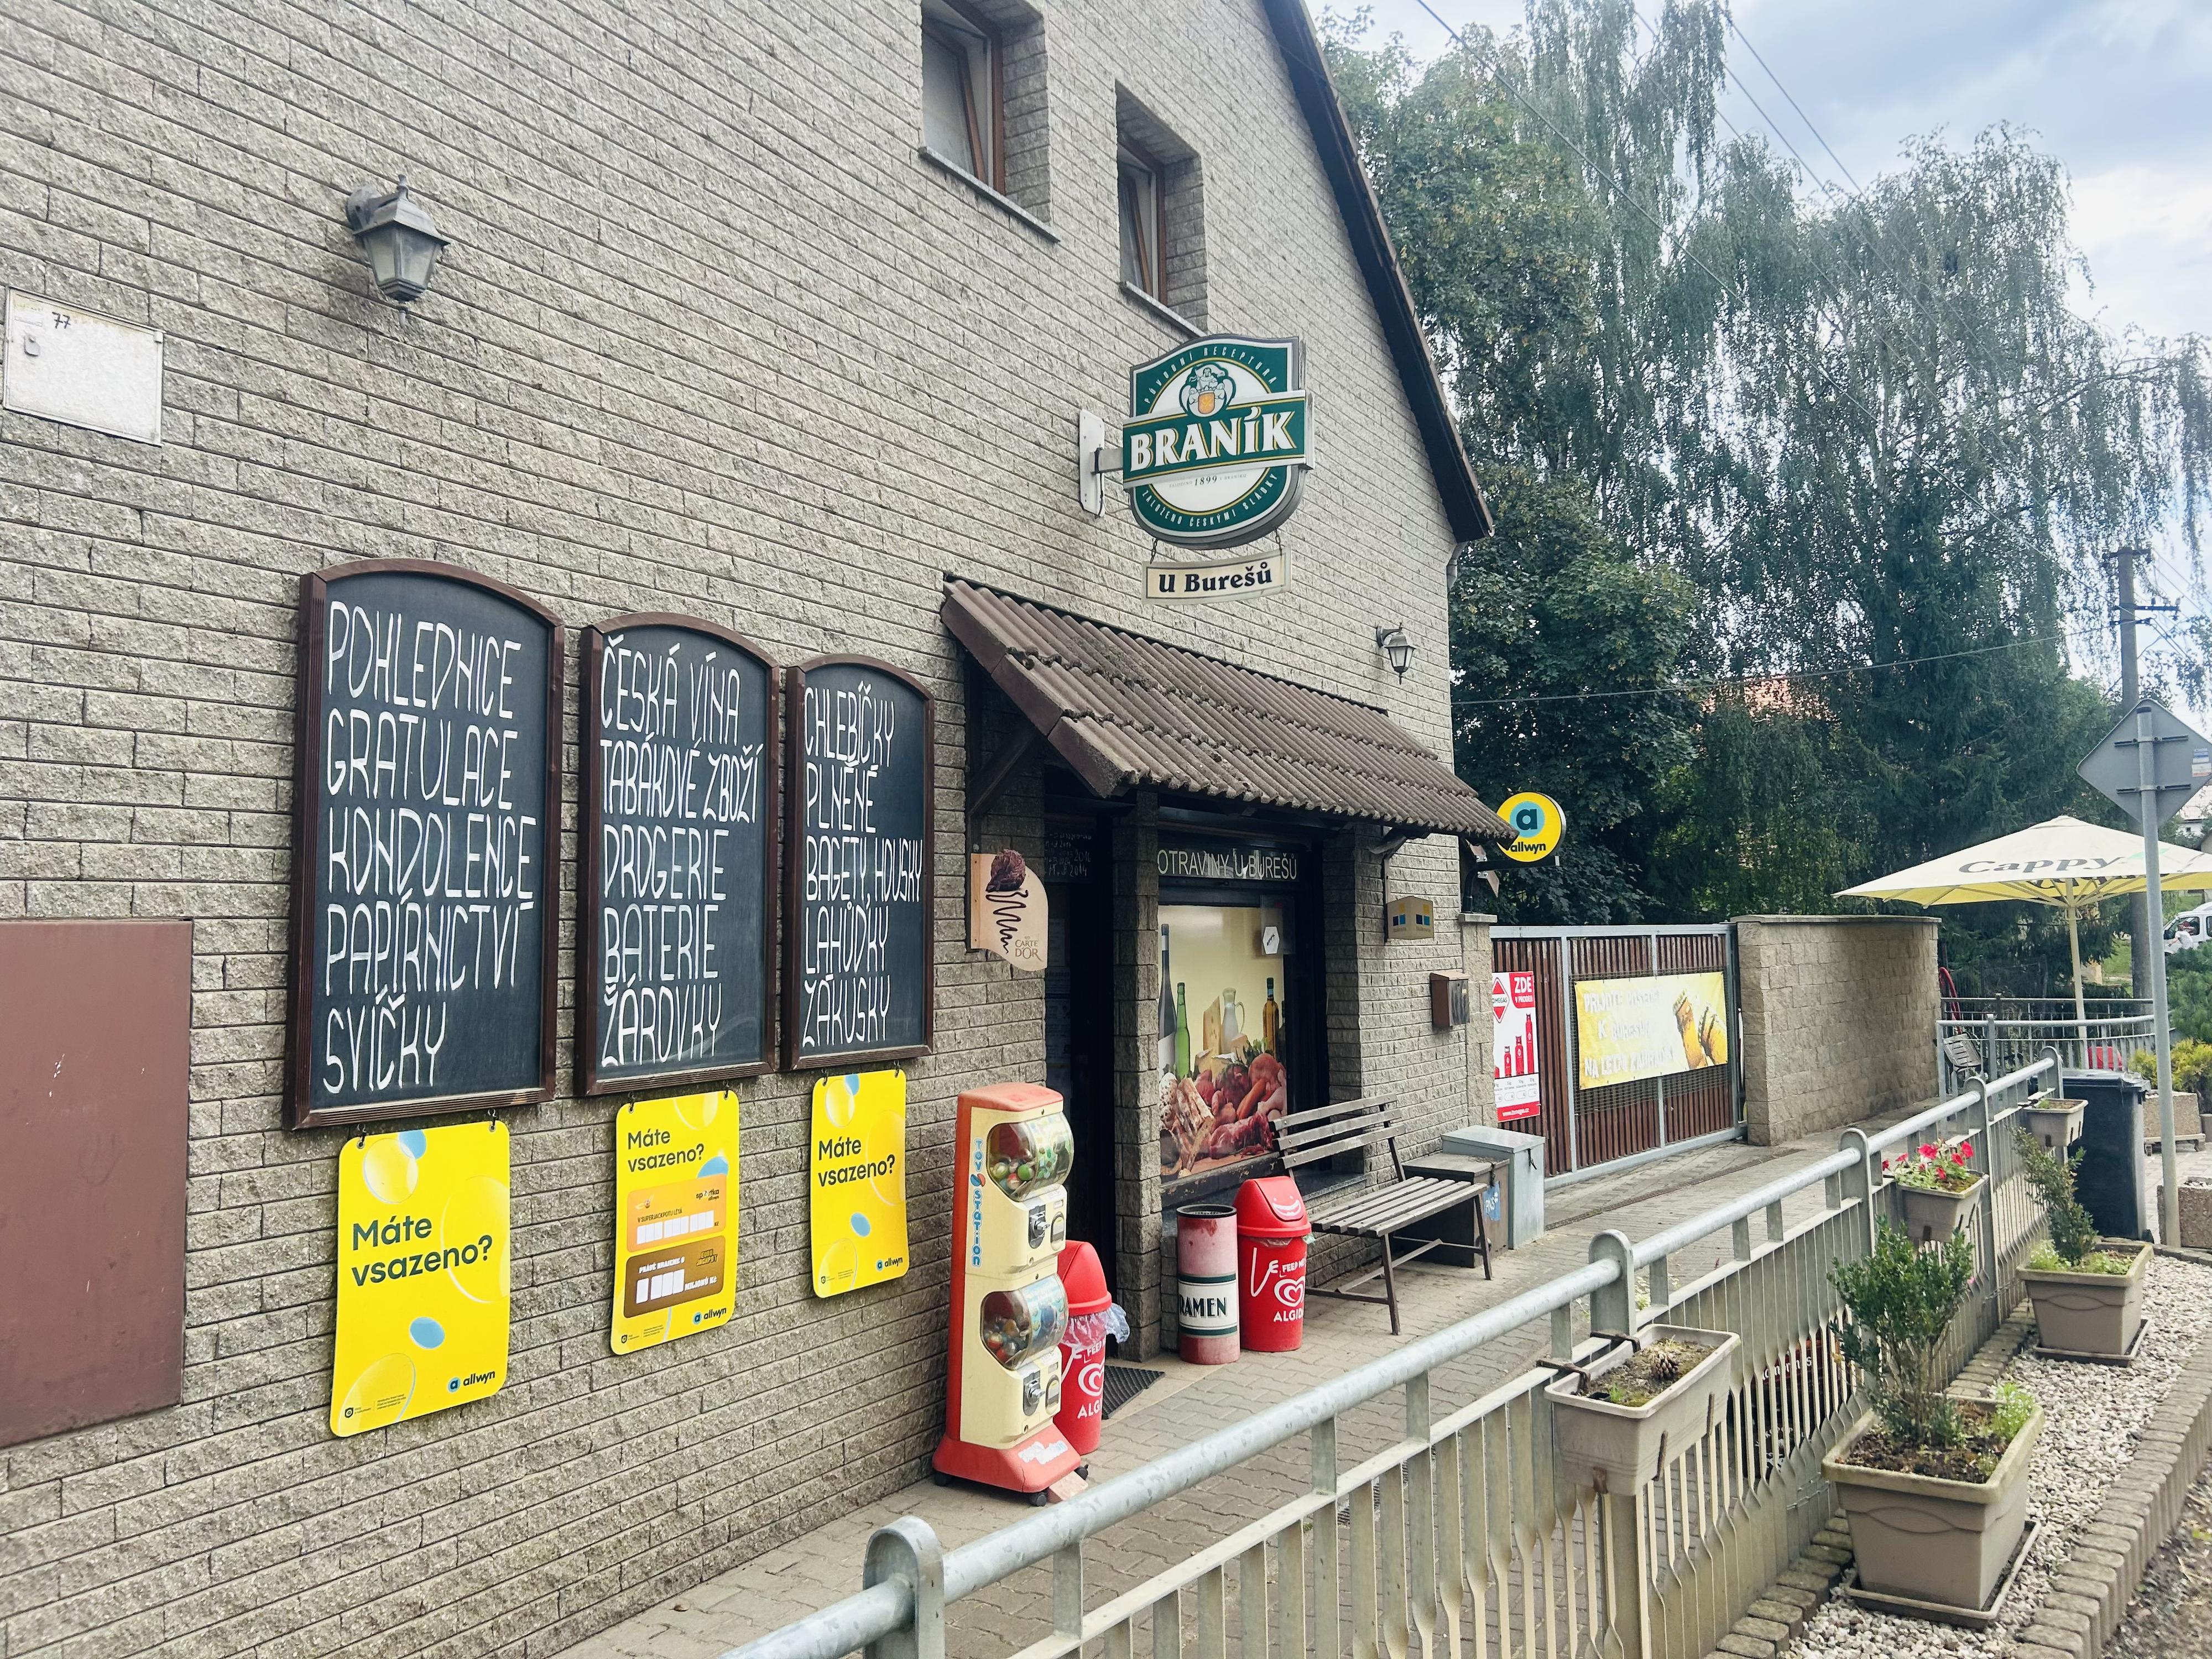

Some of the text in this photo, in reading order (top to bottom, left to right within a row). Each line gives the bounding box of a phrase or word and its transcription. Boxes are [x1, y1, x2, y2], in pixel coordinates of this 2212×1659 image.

[51, 311, 71, 329] 77
[1203, 346, 1277, 384] RECEPTURA
[1130, 405, 1296, 473] BRANÍK
[1194, 476, 1217, 486] 1899
[1142, 473, 1278, 527] ZALOŽENO ČESKÝMI SLÁDKY
[1159, 562, 1273, 593] U Burešů
[328, 601, 521, 719] POHLEDNICE
[601, 634, 740, 746] ČESKÁ VÍNA
[805, 680, 894, 768] CHLEBÍČKY
[327, 708, 518, 810] GRATULACE
[601, 732, 764, 823] TABÁKOVÉ ZBOŽÍ
[806, 760, 879, 833] PLNĚNÉ
[330, 806, 537, 899] KONDOLENCE
[604, 825, 729, 901] DROGERIE
[1157, 849, 1229, 877] OTRAVINY
[1248, 852, 1297, 880] BUREŠŮ
[1510, 841, 1546, 854] allwyn
[1959, 857, 2125, 873] Cappy
[875, 837, 922, 902] HOUSKY
[326, 888, 534, 996] PAPÍRNICTVÍ
[604, 903, 719, 983] BATERIE
[806, 901, 889, 974] LAHŮDKY
[1015, 939, 1039, 947] CARTE
[1015, 947, 1044, 962] D'OR
[1514, 976, 1532, 994] ZDE
[602, 973, 722, 1067] ŽÁROVKY
[802, 973, 890, 1047] ZÁKUSKY
[324, 984, 446, 1094] SVÍČKY
[628, 1129, 671, 1150] Máte
[628, 1143, 705, 1172] vsazeno?
[818, 1136, 862, 1161] Máte
[818, 1154, 896, 1187] vsazeno?
[353, 1214, 431, 1251] Máte
[351, 1234, 493, 1286] vsazeno?
[884, 1257, 903, 1267] allwyn
[1282, 1261, 1298, 1273] FEED
[703, 1307, 727, 1319] allwyn
[463, 1370, 495, 1387] allwyn
[1077, 1398, 1103, 1419] ALGI
